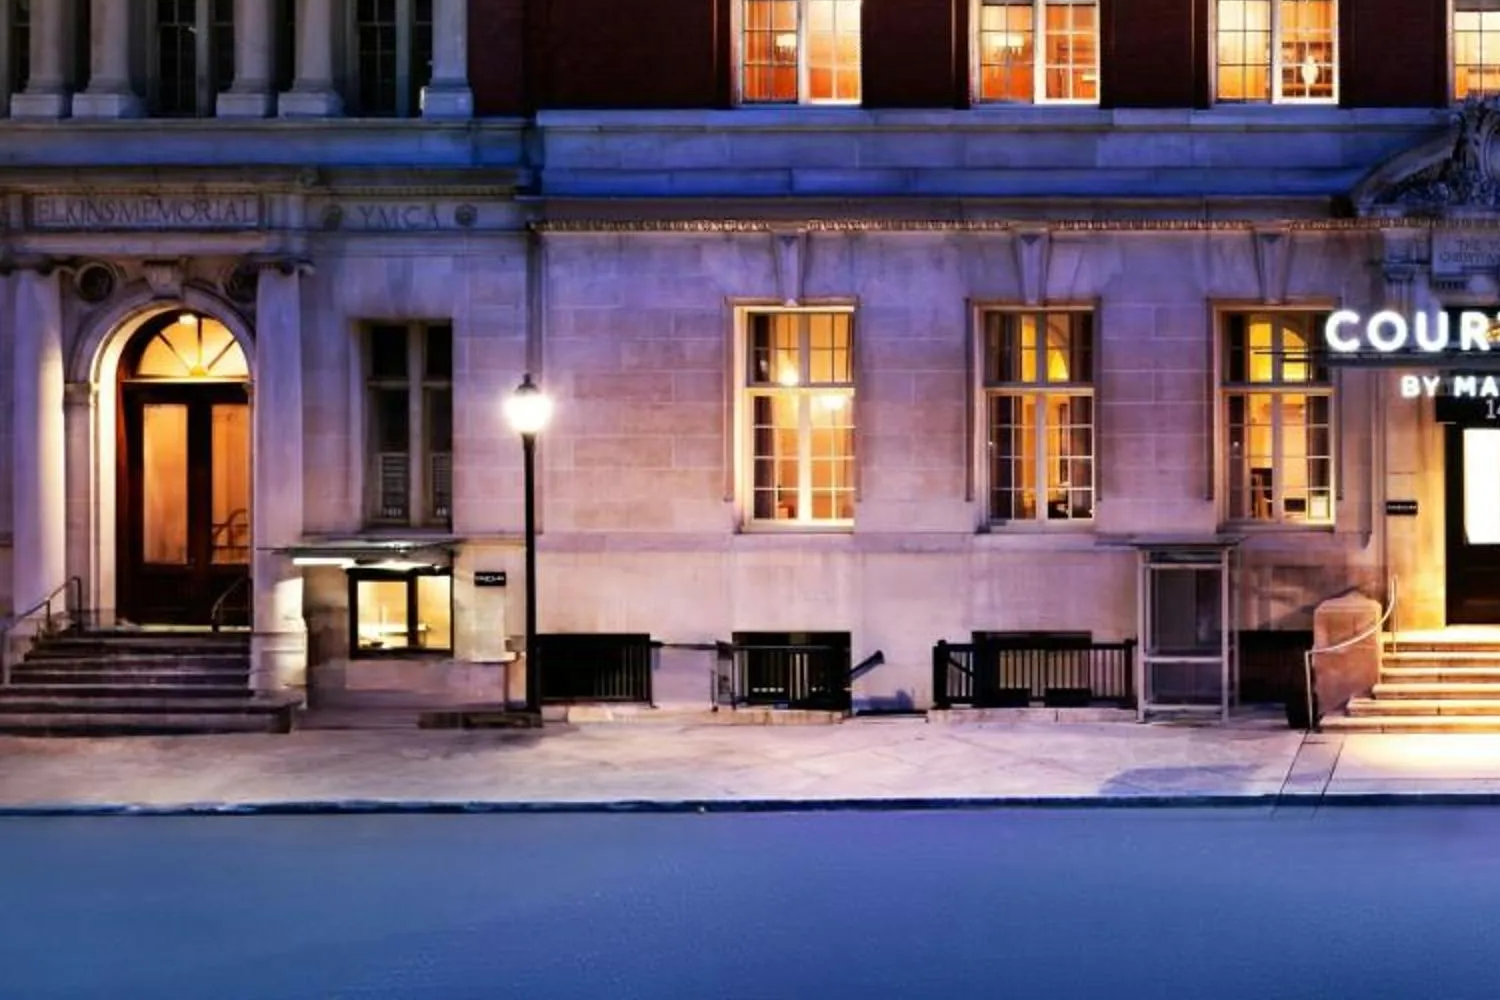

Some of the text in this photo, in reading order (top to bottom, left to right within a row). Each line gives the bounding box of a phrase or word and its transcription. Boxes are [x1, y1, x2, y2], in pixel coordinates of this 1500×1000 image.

[37, 202, 255, 223] ELKINS MEMORIAL
[357, 205, 441, 230] YMCA
[1400, 375, 1440, 398] BY
